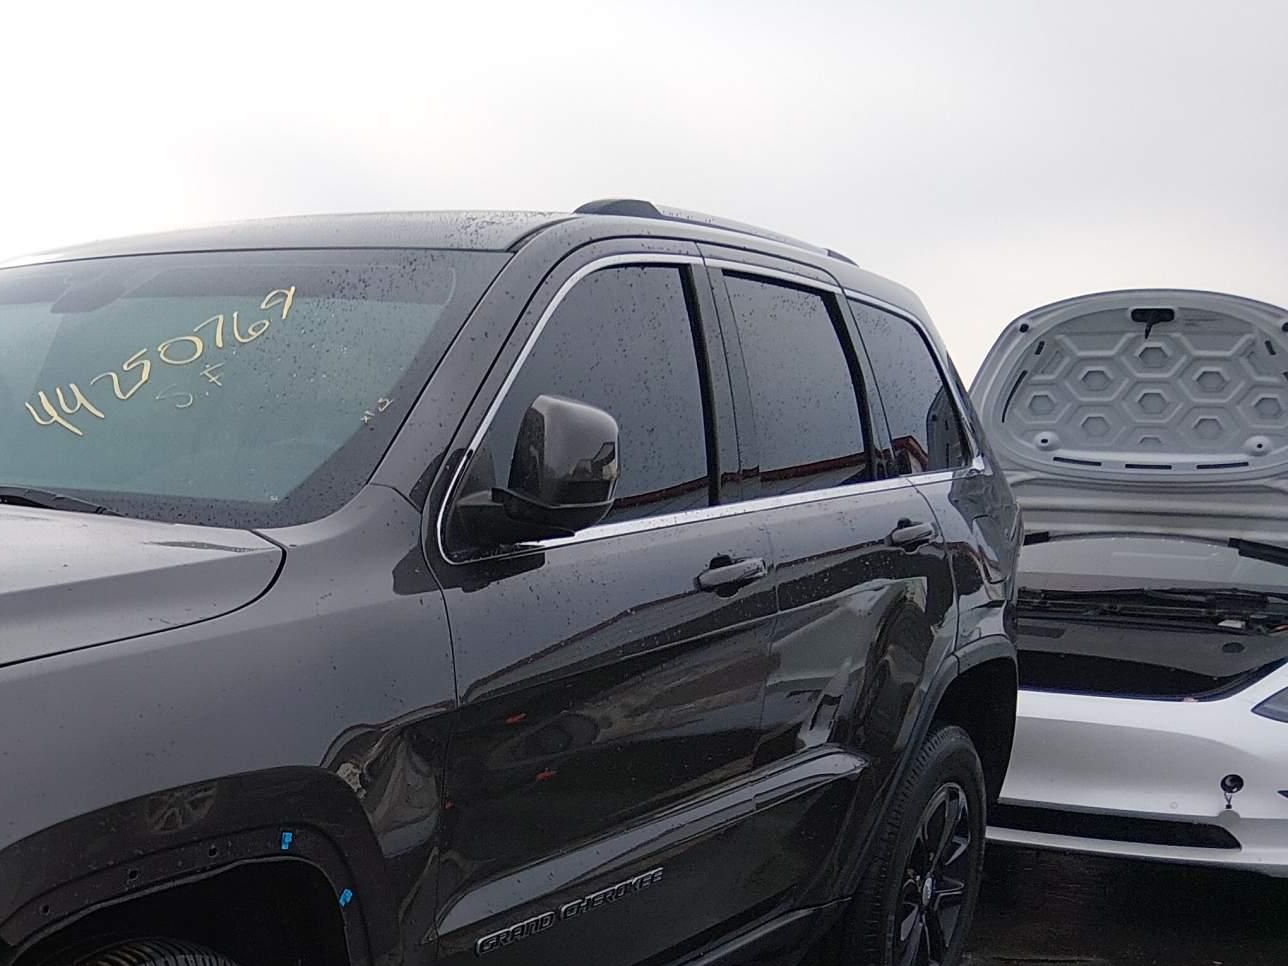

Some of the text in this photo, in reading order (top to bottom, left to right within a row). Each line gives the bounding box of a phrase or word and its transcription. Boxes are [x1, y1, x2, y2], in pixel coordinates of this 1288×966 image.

[25, 286, 296, 436] 44250769
[476, 866, 664, 957] GRAND CHEROKEE
